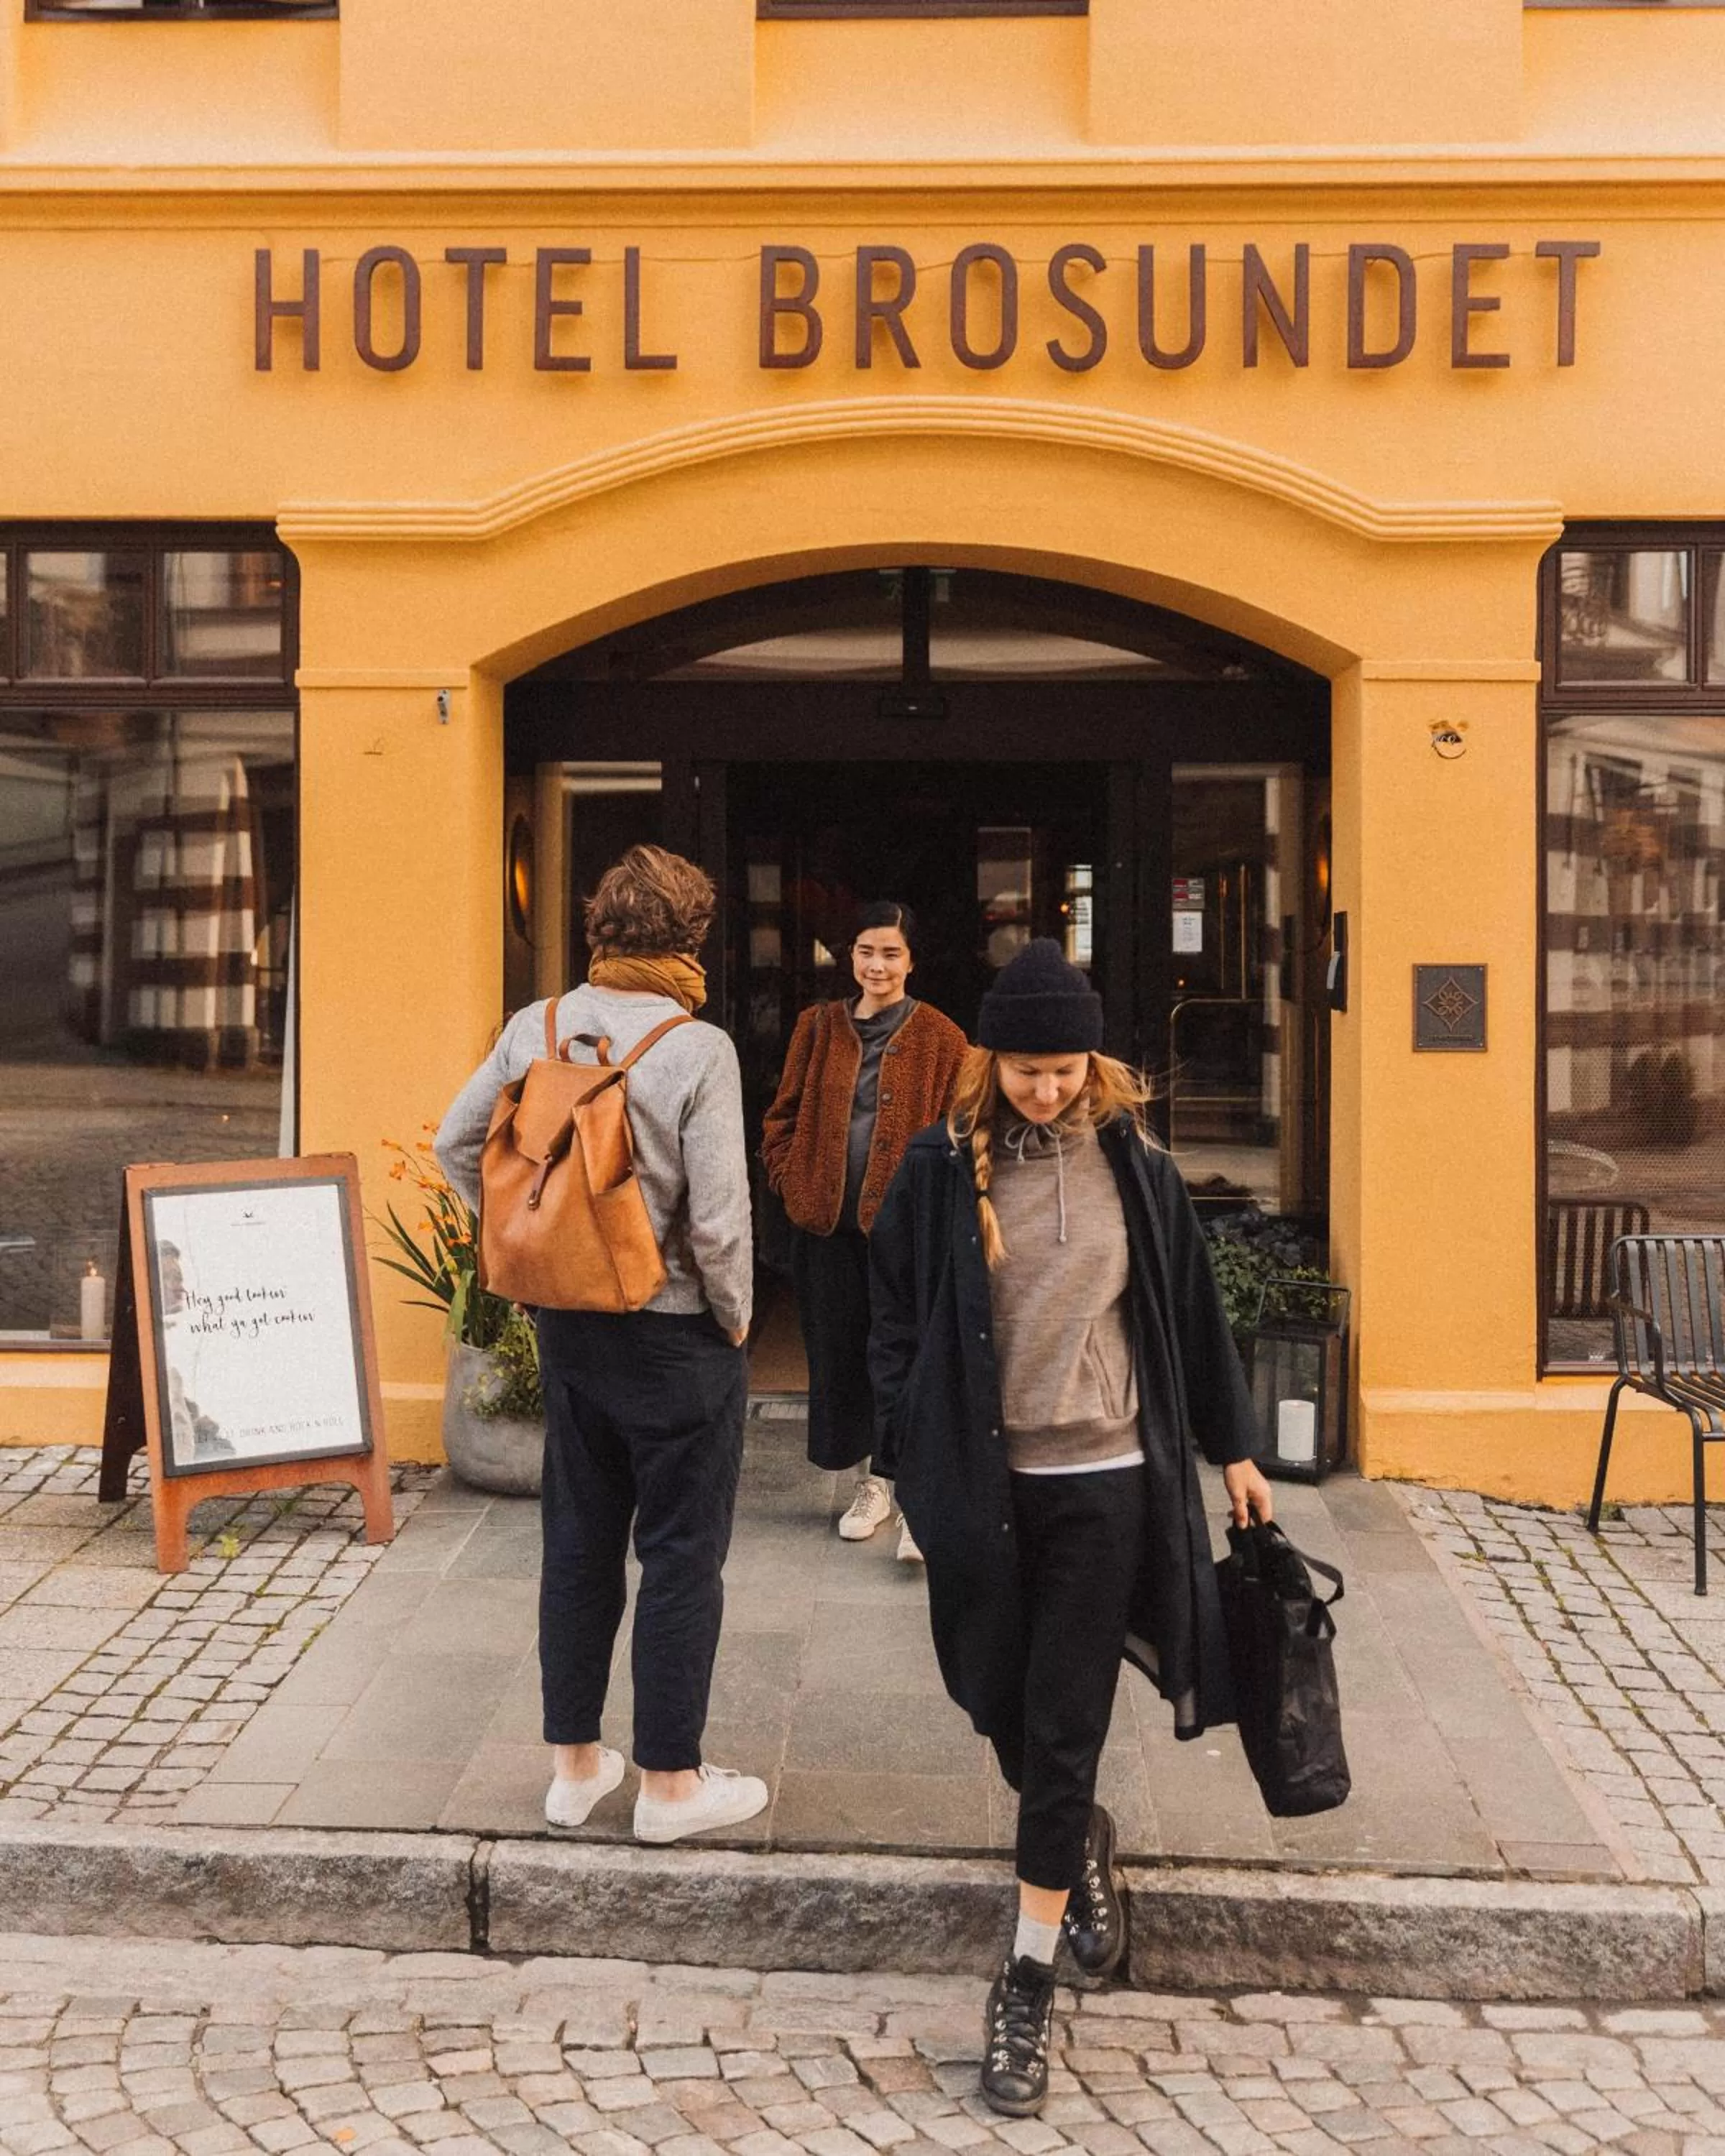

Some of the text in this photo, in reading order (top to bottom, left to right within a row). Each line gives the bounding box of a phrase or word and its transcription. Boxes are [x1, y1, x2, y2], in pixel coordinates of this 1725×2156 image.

[255, 241, 1600, 373] HOTEL BROSUNDET
[186, 1290, 213, 1314] Hey
[218, 1287, 242, 1315] good
[190, 1312, 224, 1334] what
[230, 1319, 247, 1339] ya
[249, 1312, 270, 1339] got
